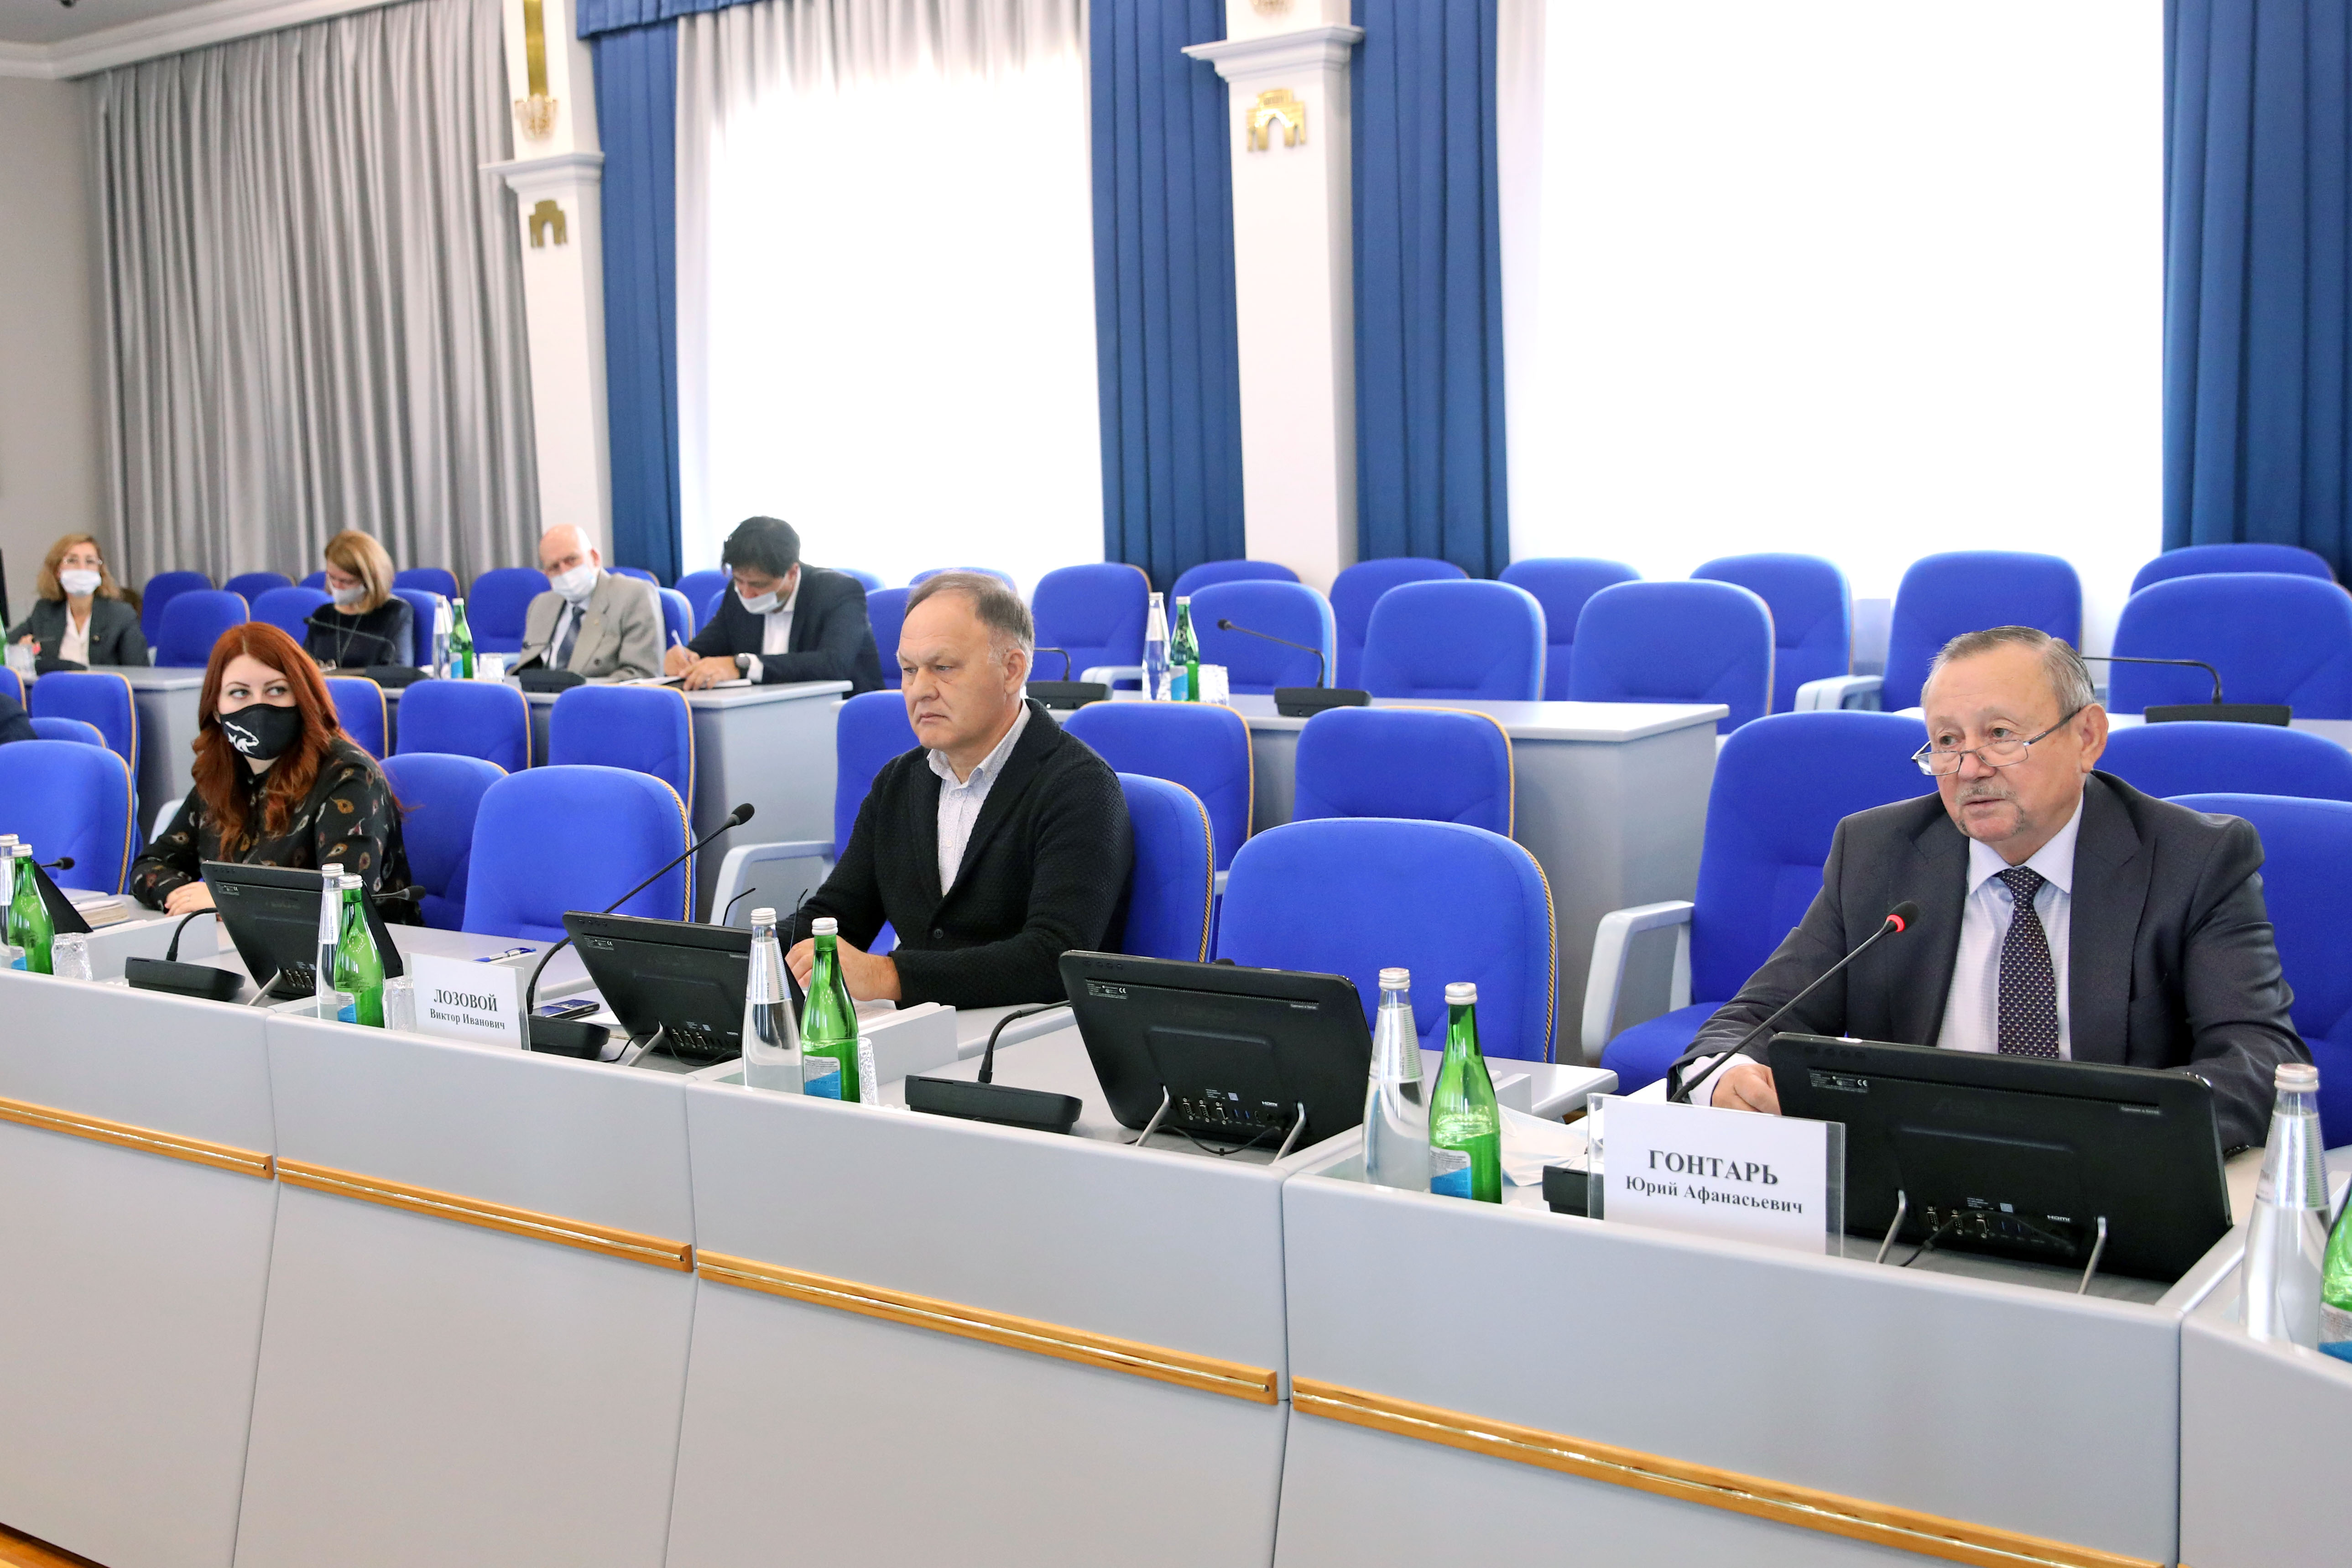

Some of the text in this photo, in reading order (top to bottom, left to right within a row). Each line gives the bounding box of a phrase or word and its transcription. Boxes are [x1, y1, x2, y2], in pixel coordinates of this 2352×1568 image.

[433, 989, 497, 1012] ЛОЗОВОЙ
[430, 1008, 505, 1029] Виктор Иванович
[1648, 1149, 1778, 1185] ГОНТАРЬ
[1626, 1175, 1803, 1214] Юрий Афанасьевич
